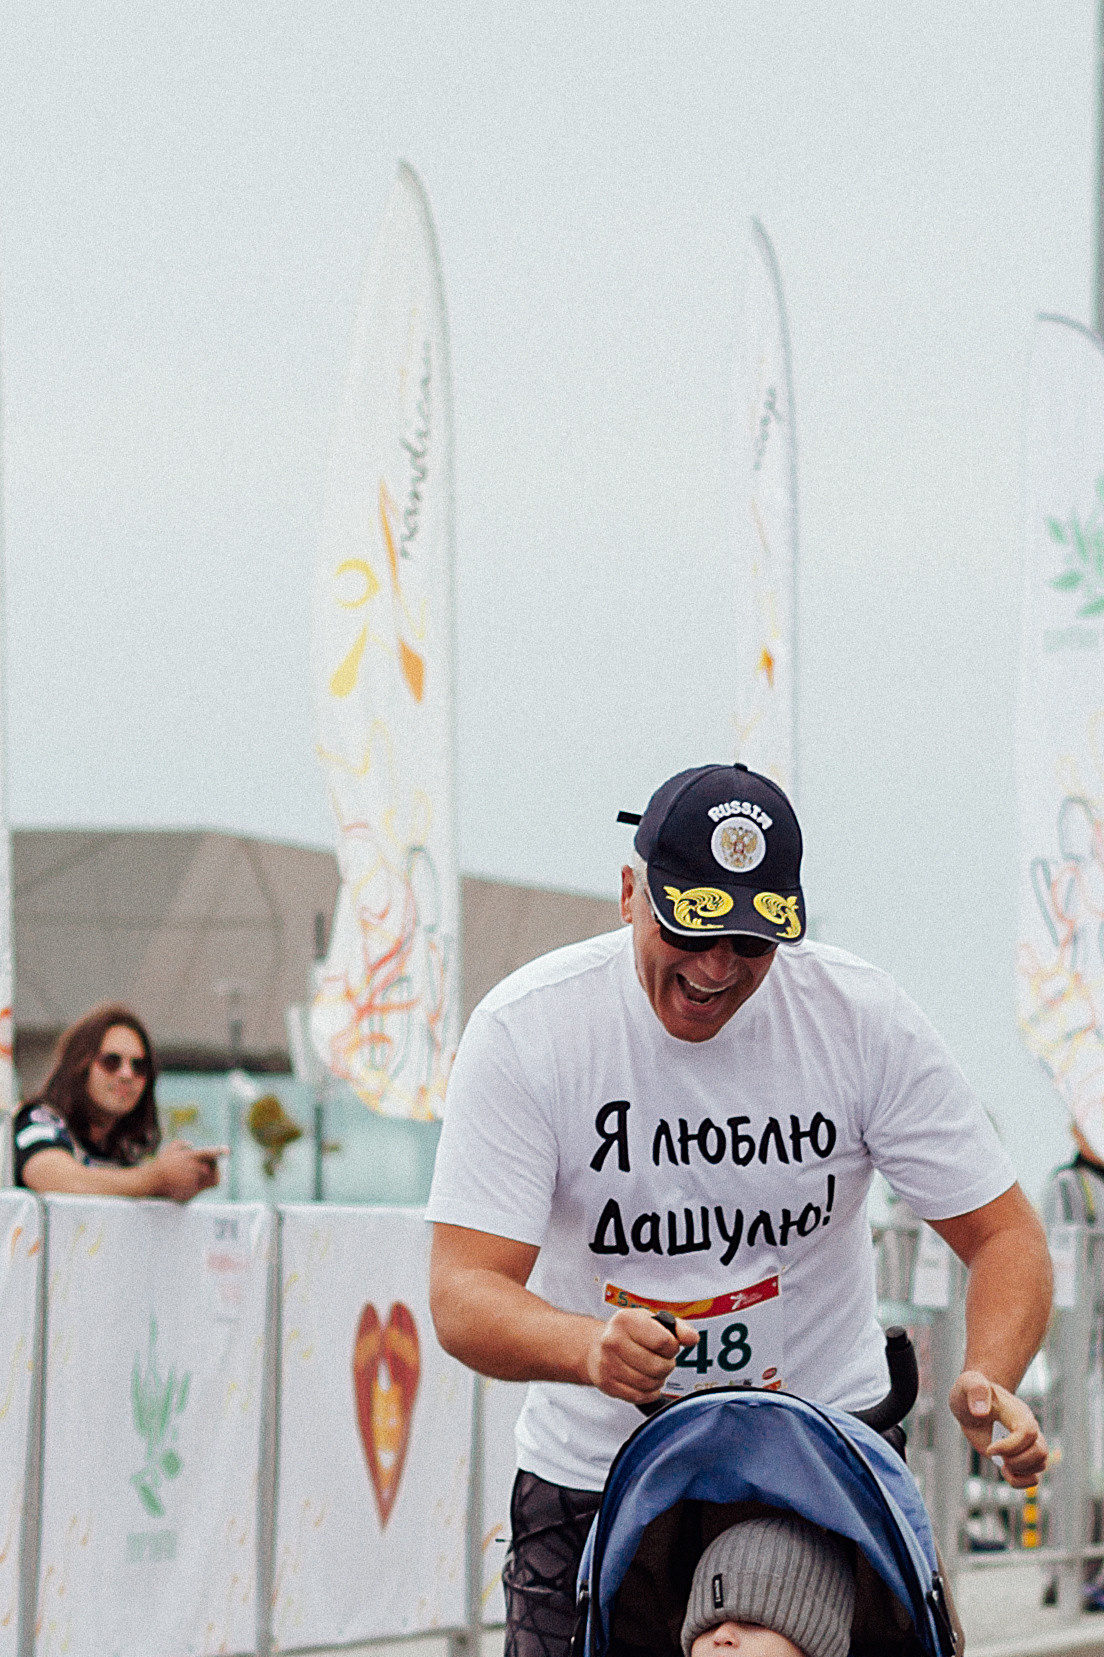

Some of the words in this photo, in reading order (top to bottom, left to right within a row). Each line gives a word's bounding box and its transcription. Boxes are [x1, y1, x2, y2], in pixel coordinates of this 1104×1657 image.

[707, 800, 773, 830] RUSSIA
[589, 1100, 631, 1173] Я
[588, 1174, 836, 1266] Дашулю!
[675, 1322, 753, 1375] 48
